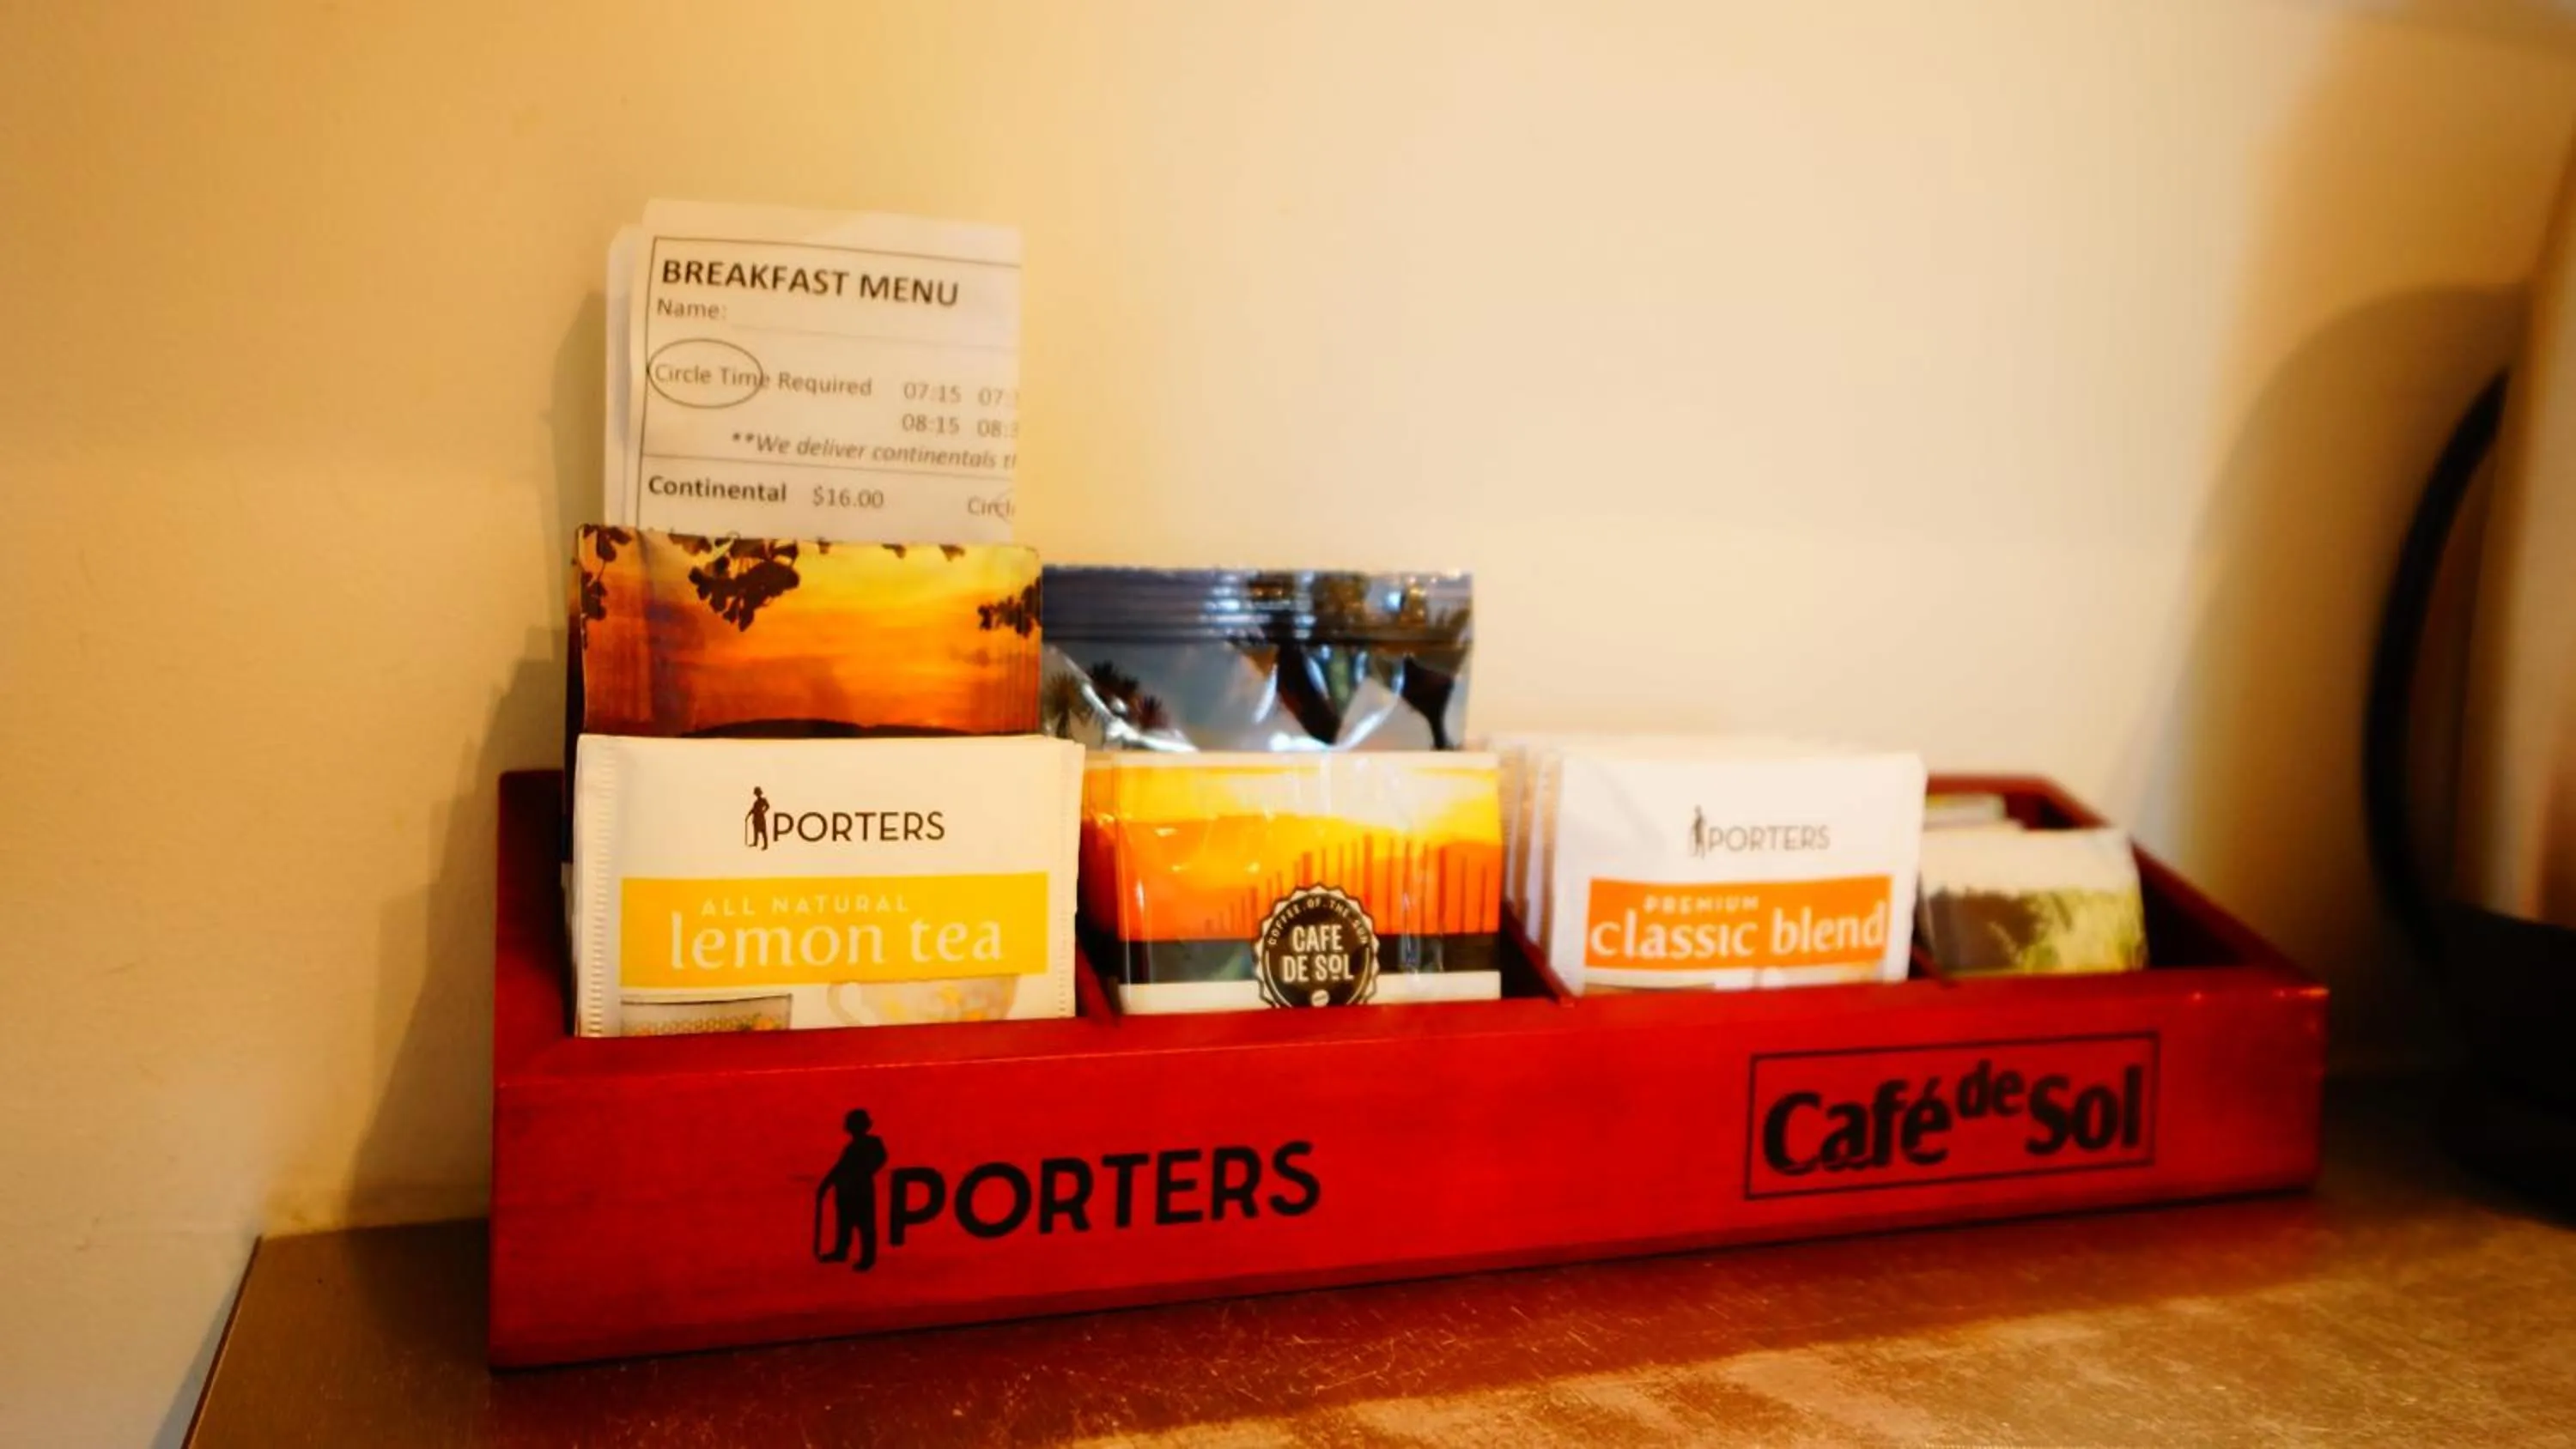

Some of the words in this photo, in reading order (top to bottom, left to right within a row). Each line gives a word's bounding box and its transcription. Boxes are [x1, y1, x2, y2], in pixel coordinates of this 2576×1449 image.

[661, 259, 850, 297] BREAKFAST
[860, 274, 959, 307] MENU
[657, 299, 726, 321] Name:
[654, 364, 712, 385] Circle
[720, 367, 770, 388] Time
[778, 372, 872, 397] Required
[903, 382, 962, 403] 07:15
[902, 413, 960, 434] 08:15
[797, 436, 866, 459] deliver
[872, 446, 996, 469] continentals
[648, 476, 787, 502] Continental
[812, 488, 884, 509] $16.00
[773, 810, 945, 843] PORTERS
[1708, 825, 1831, 852] PORTERS
[701, 897, 755, 917] ALL
[772, 894, 910, 915] NATURAL
[1643, 894, 1759, 914] PREMIUM
[1267, 904, 1302, 945] COFFEE
[1307, 897, 1321, 908] OF
[1590, 907, 1759, 960] classic
[1771, 901, 1888, 955] blend
[671, 911, 884, 970] lemon
[909, 919, 1004, 964] tea
[1292, 925, 1344, 952] CAFE
[1282, 955, 1309, 983] DE
[1762, 1076, 1953, 1176] Café
[1955, 1058, 2026, 1118] de
[2025, 1064, 2144, 1156] Sol
[888, 1140, 1321, 1247] PORTERS
